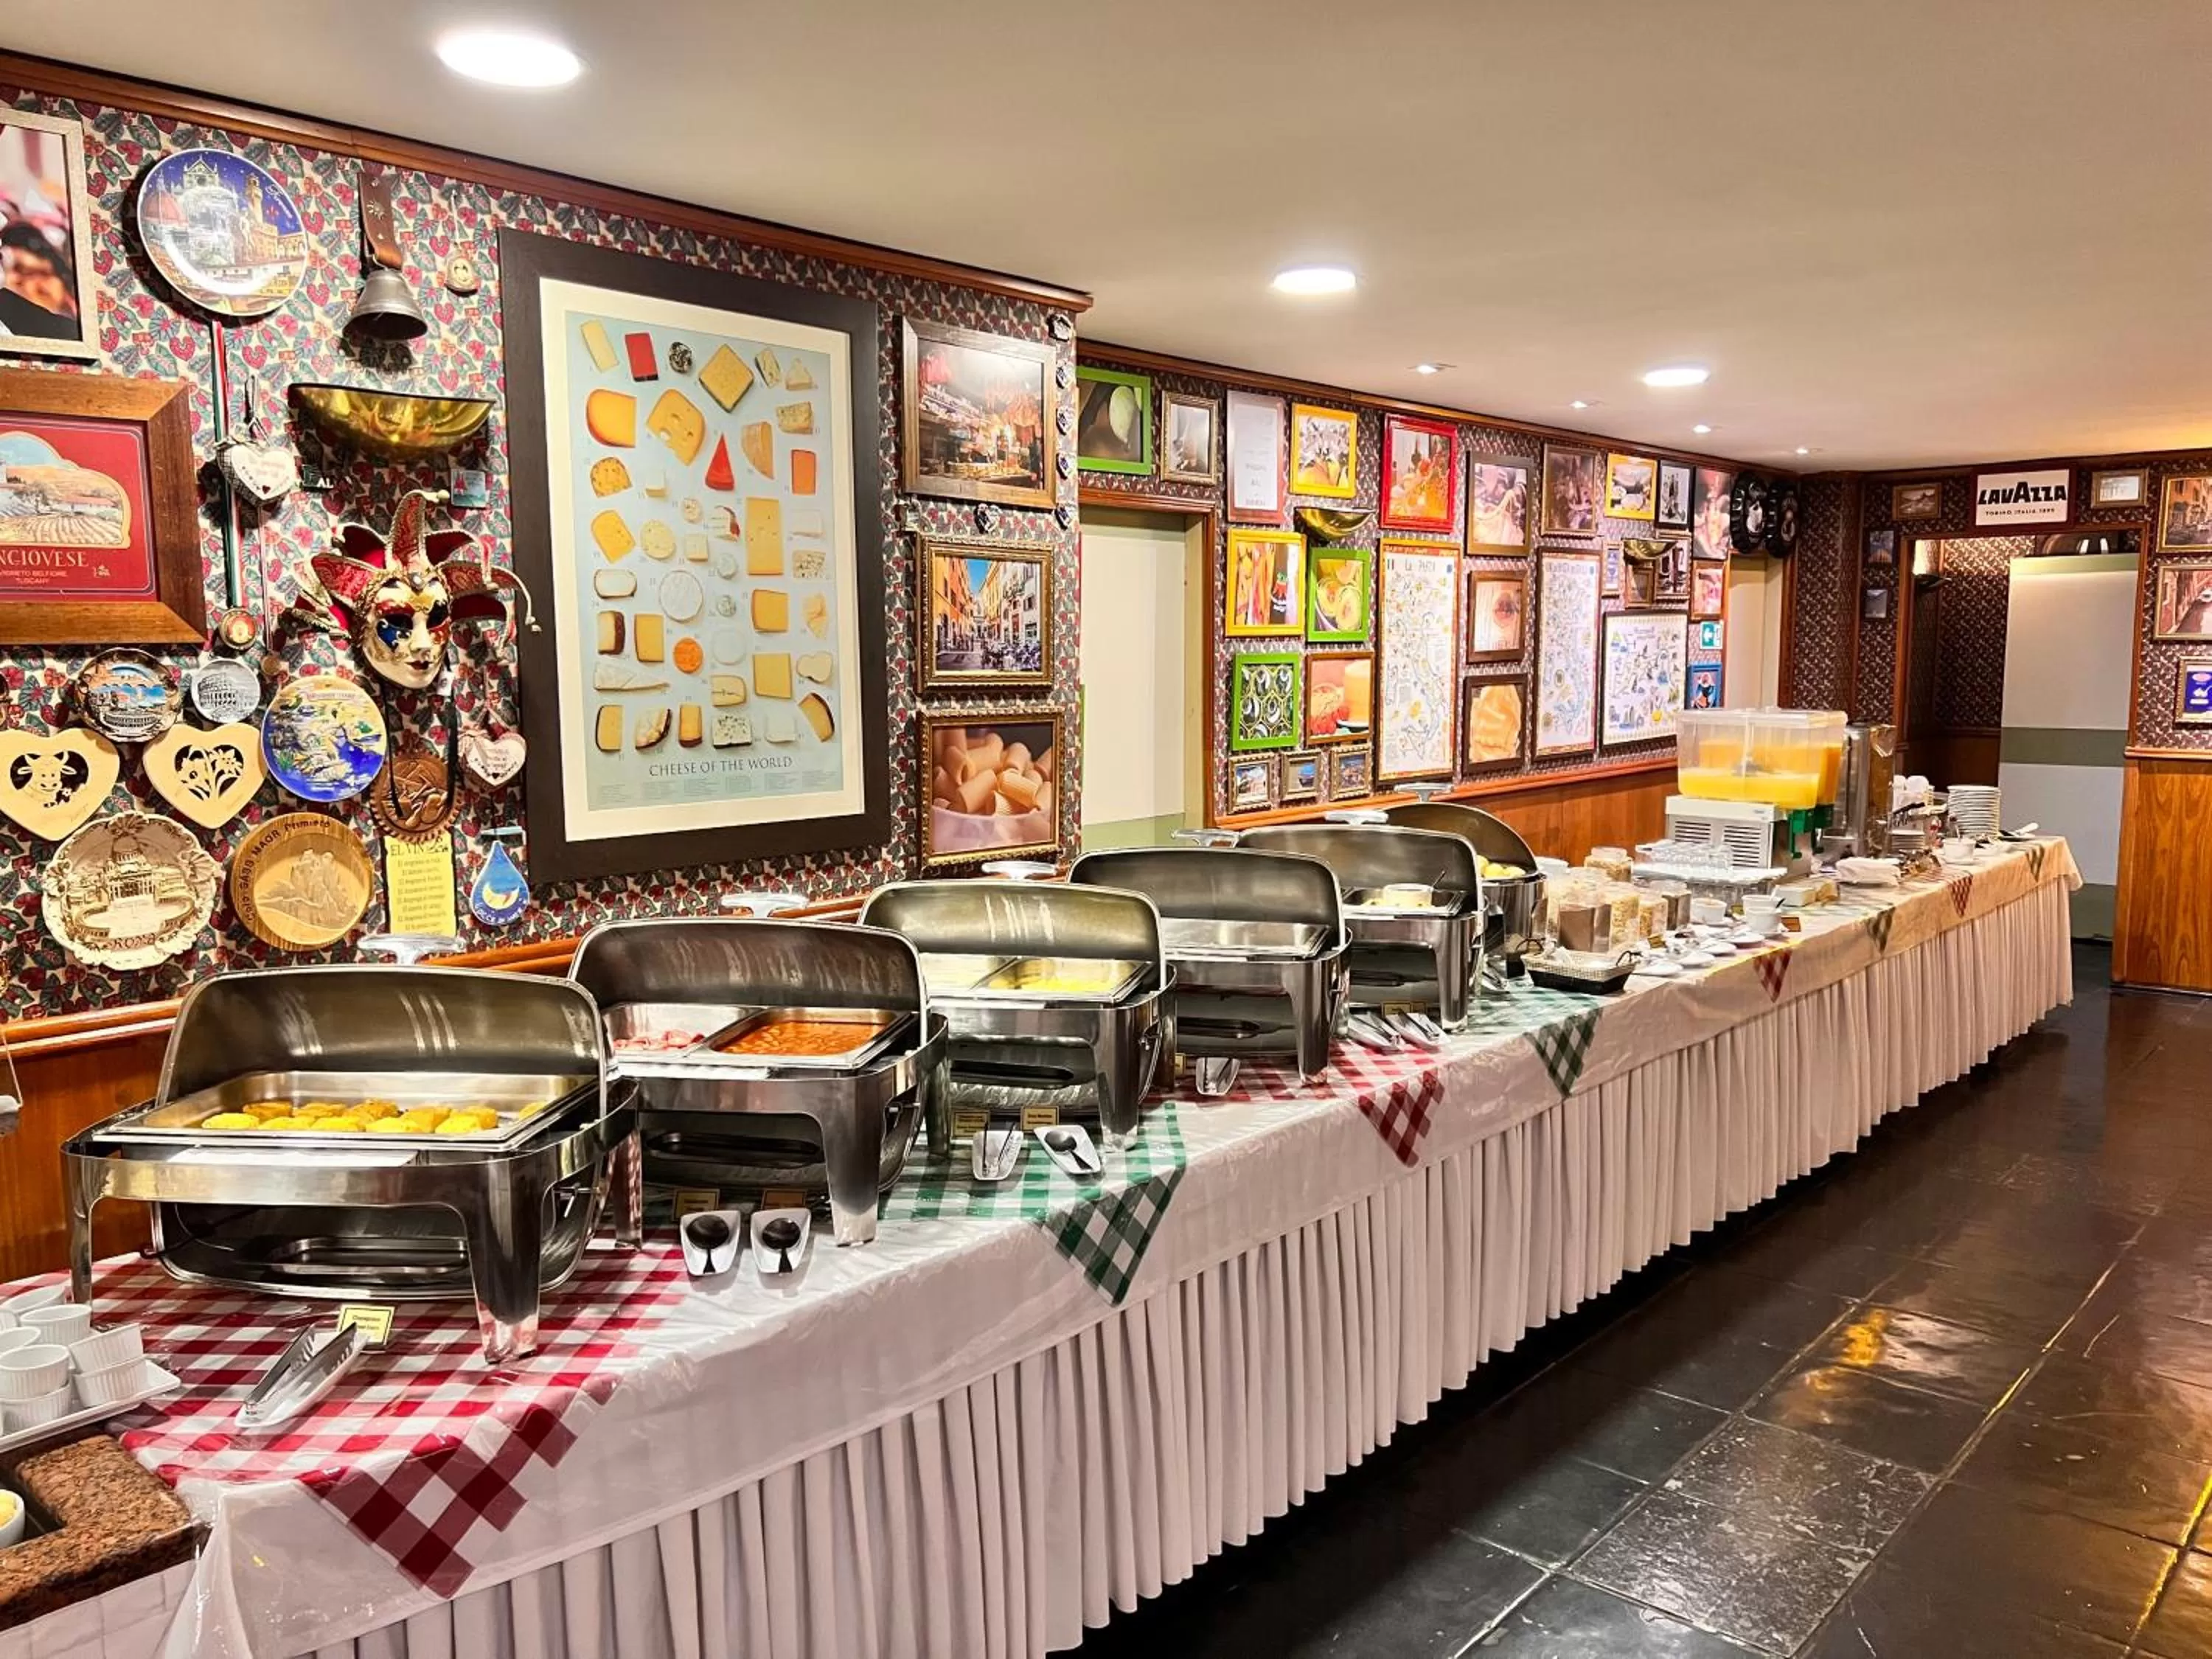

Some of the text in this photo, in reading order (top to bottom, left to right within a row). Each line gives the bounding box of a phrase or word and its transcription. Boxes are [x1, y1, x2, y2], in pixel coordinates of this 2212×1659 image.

[1978, 481, 2066, 504] LAVAZZA
[649, 757, 793, 776] CHEESE OF THE WORLD
